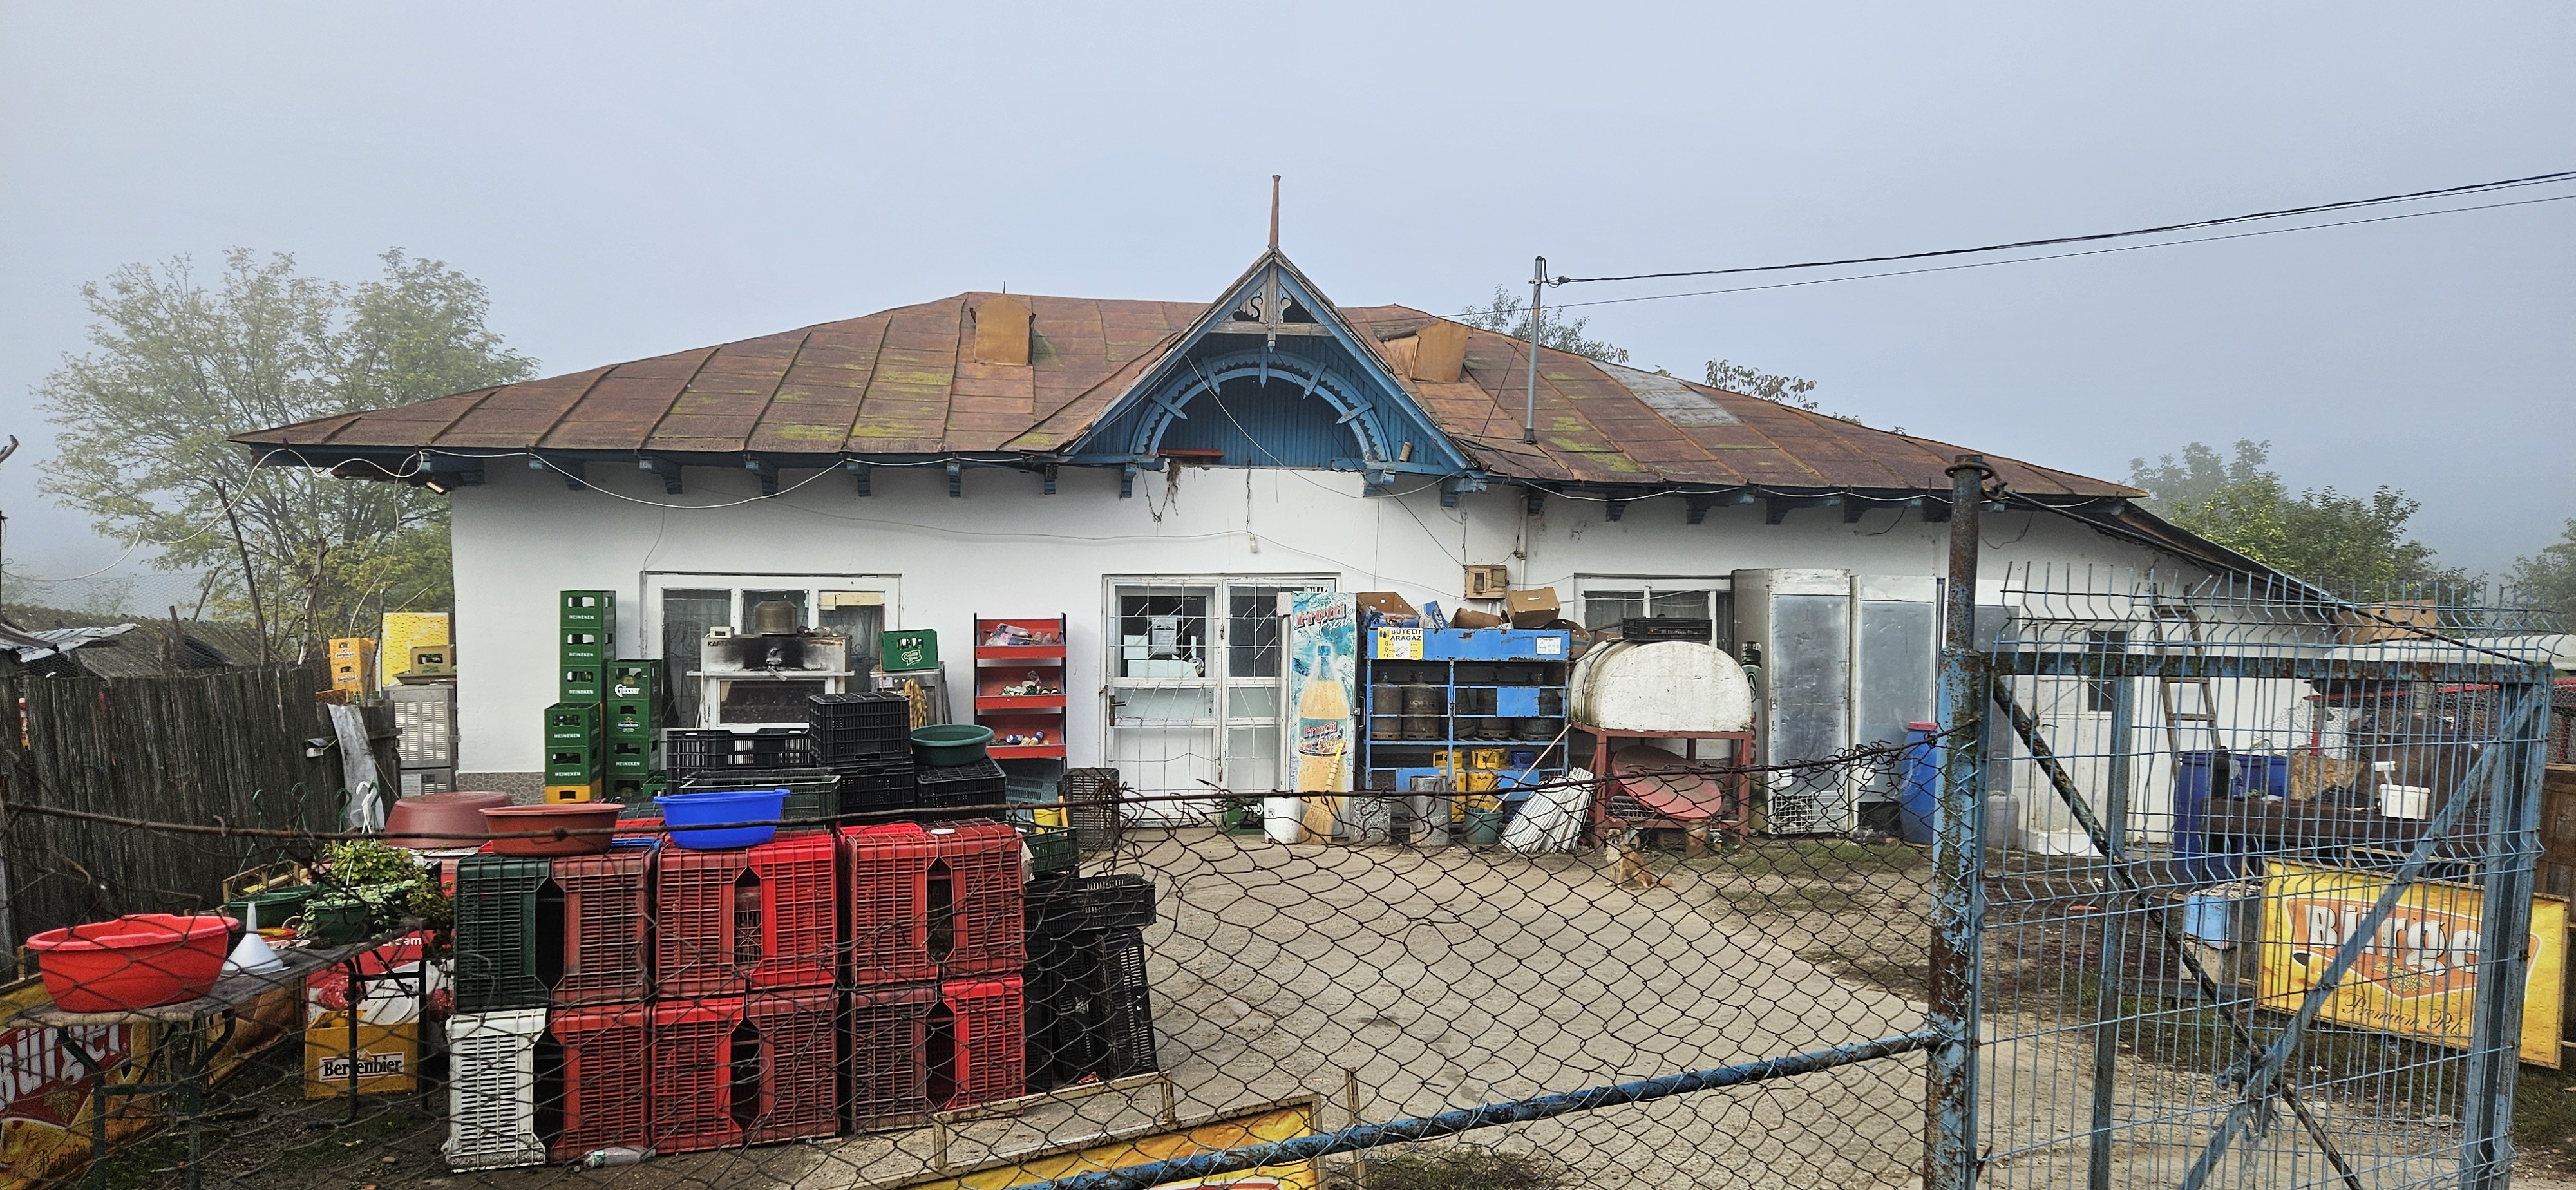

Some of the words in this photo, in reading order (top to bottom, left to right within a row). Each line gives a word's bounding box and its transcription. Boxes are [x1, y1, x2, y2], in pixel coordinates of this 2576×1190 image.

[1296, 602, 1346, 627] Frutti
[1319, 608, 1353, 635] Fresh
[614, 684, 640, 697] Gösser
[1303, 720, 1338, 739] Frutti
[2342, 992, 2420, 1028] Premium
[2427, 1008, 2464, 1035] Pils
[323, 1055, 402, 1077] Berenbier
